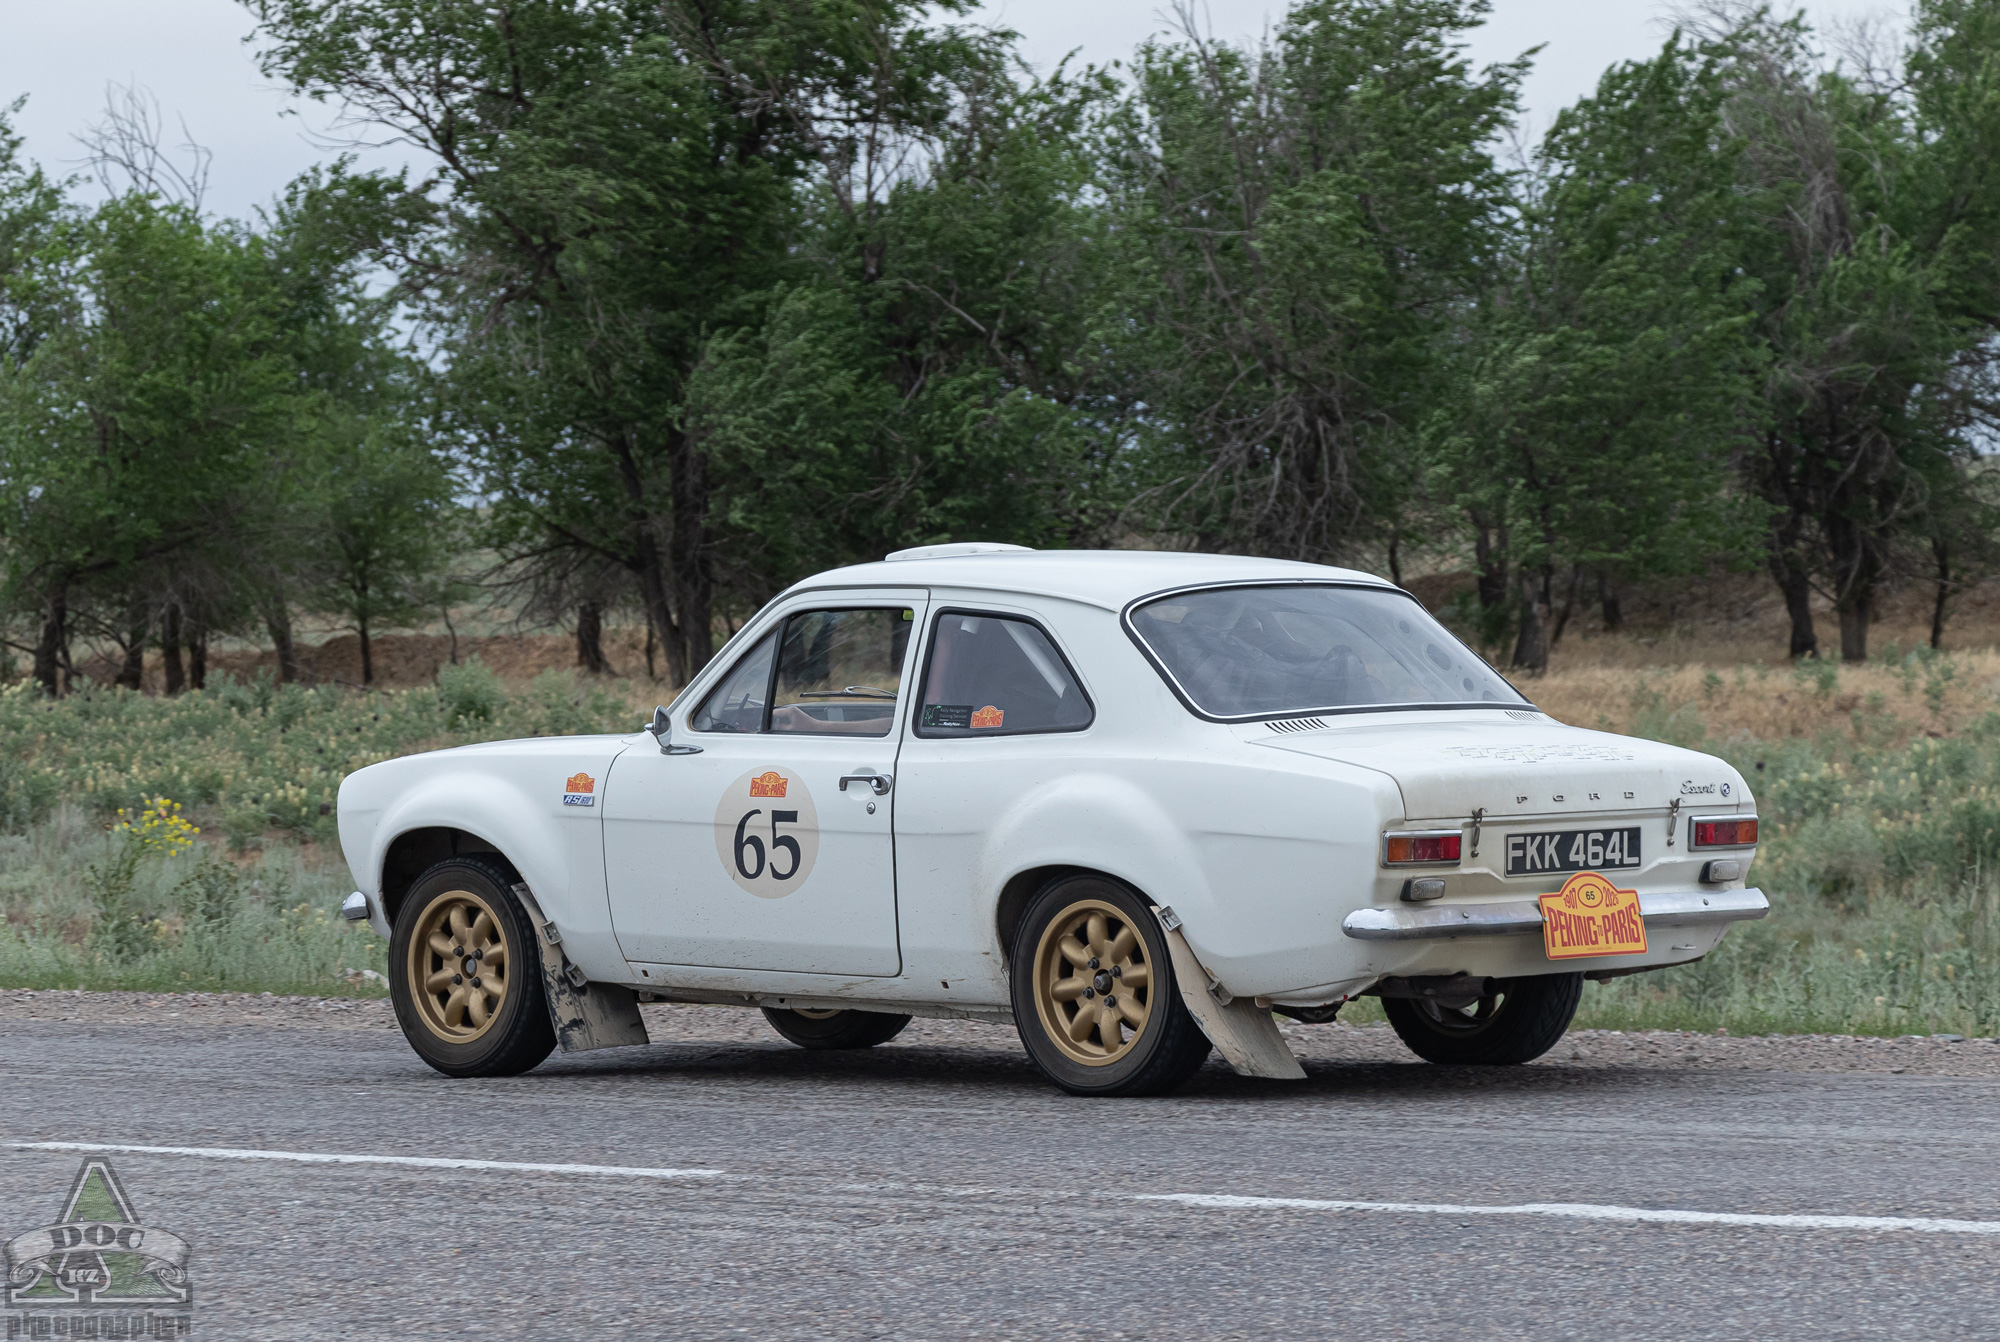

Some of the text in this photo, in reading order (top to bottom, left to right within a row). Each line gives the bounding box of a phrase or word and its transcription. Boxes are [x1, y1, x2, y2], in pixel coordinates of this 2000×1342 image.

[1516, 791, 1635, 804] FORD
[733, 808, 802, 881] 65
[1507, 831, 1639, 871] FKK 464L
[1585, 890, 1596, 901] 65
[1546, 906, 1599, 947] PEKING
[1601, 902, 1641, 945] PARIS
